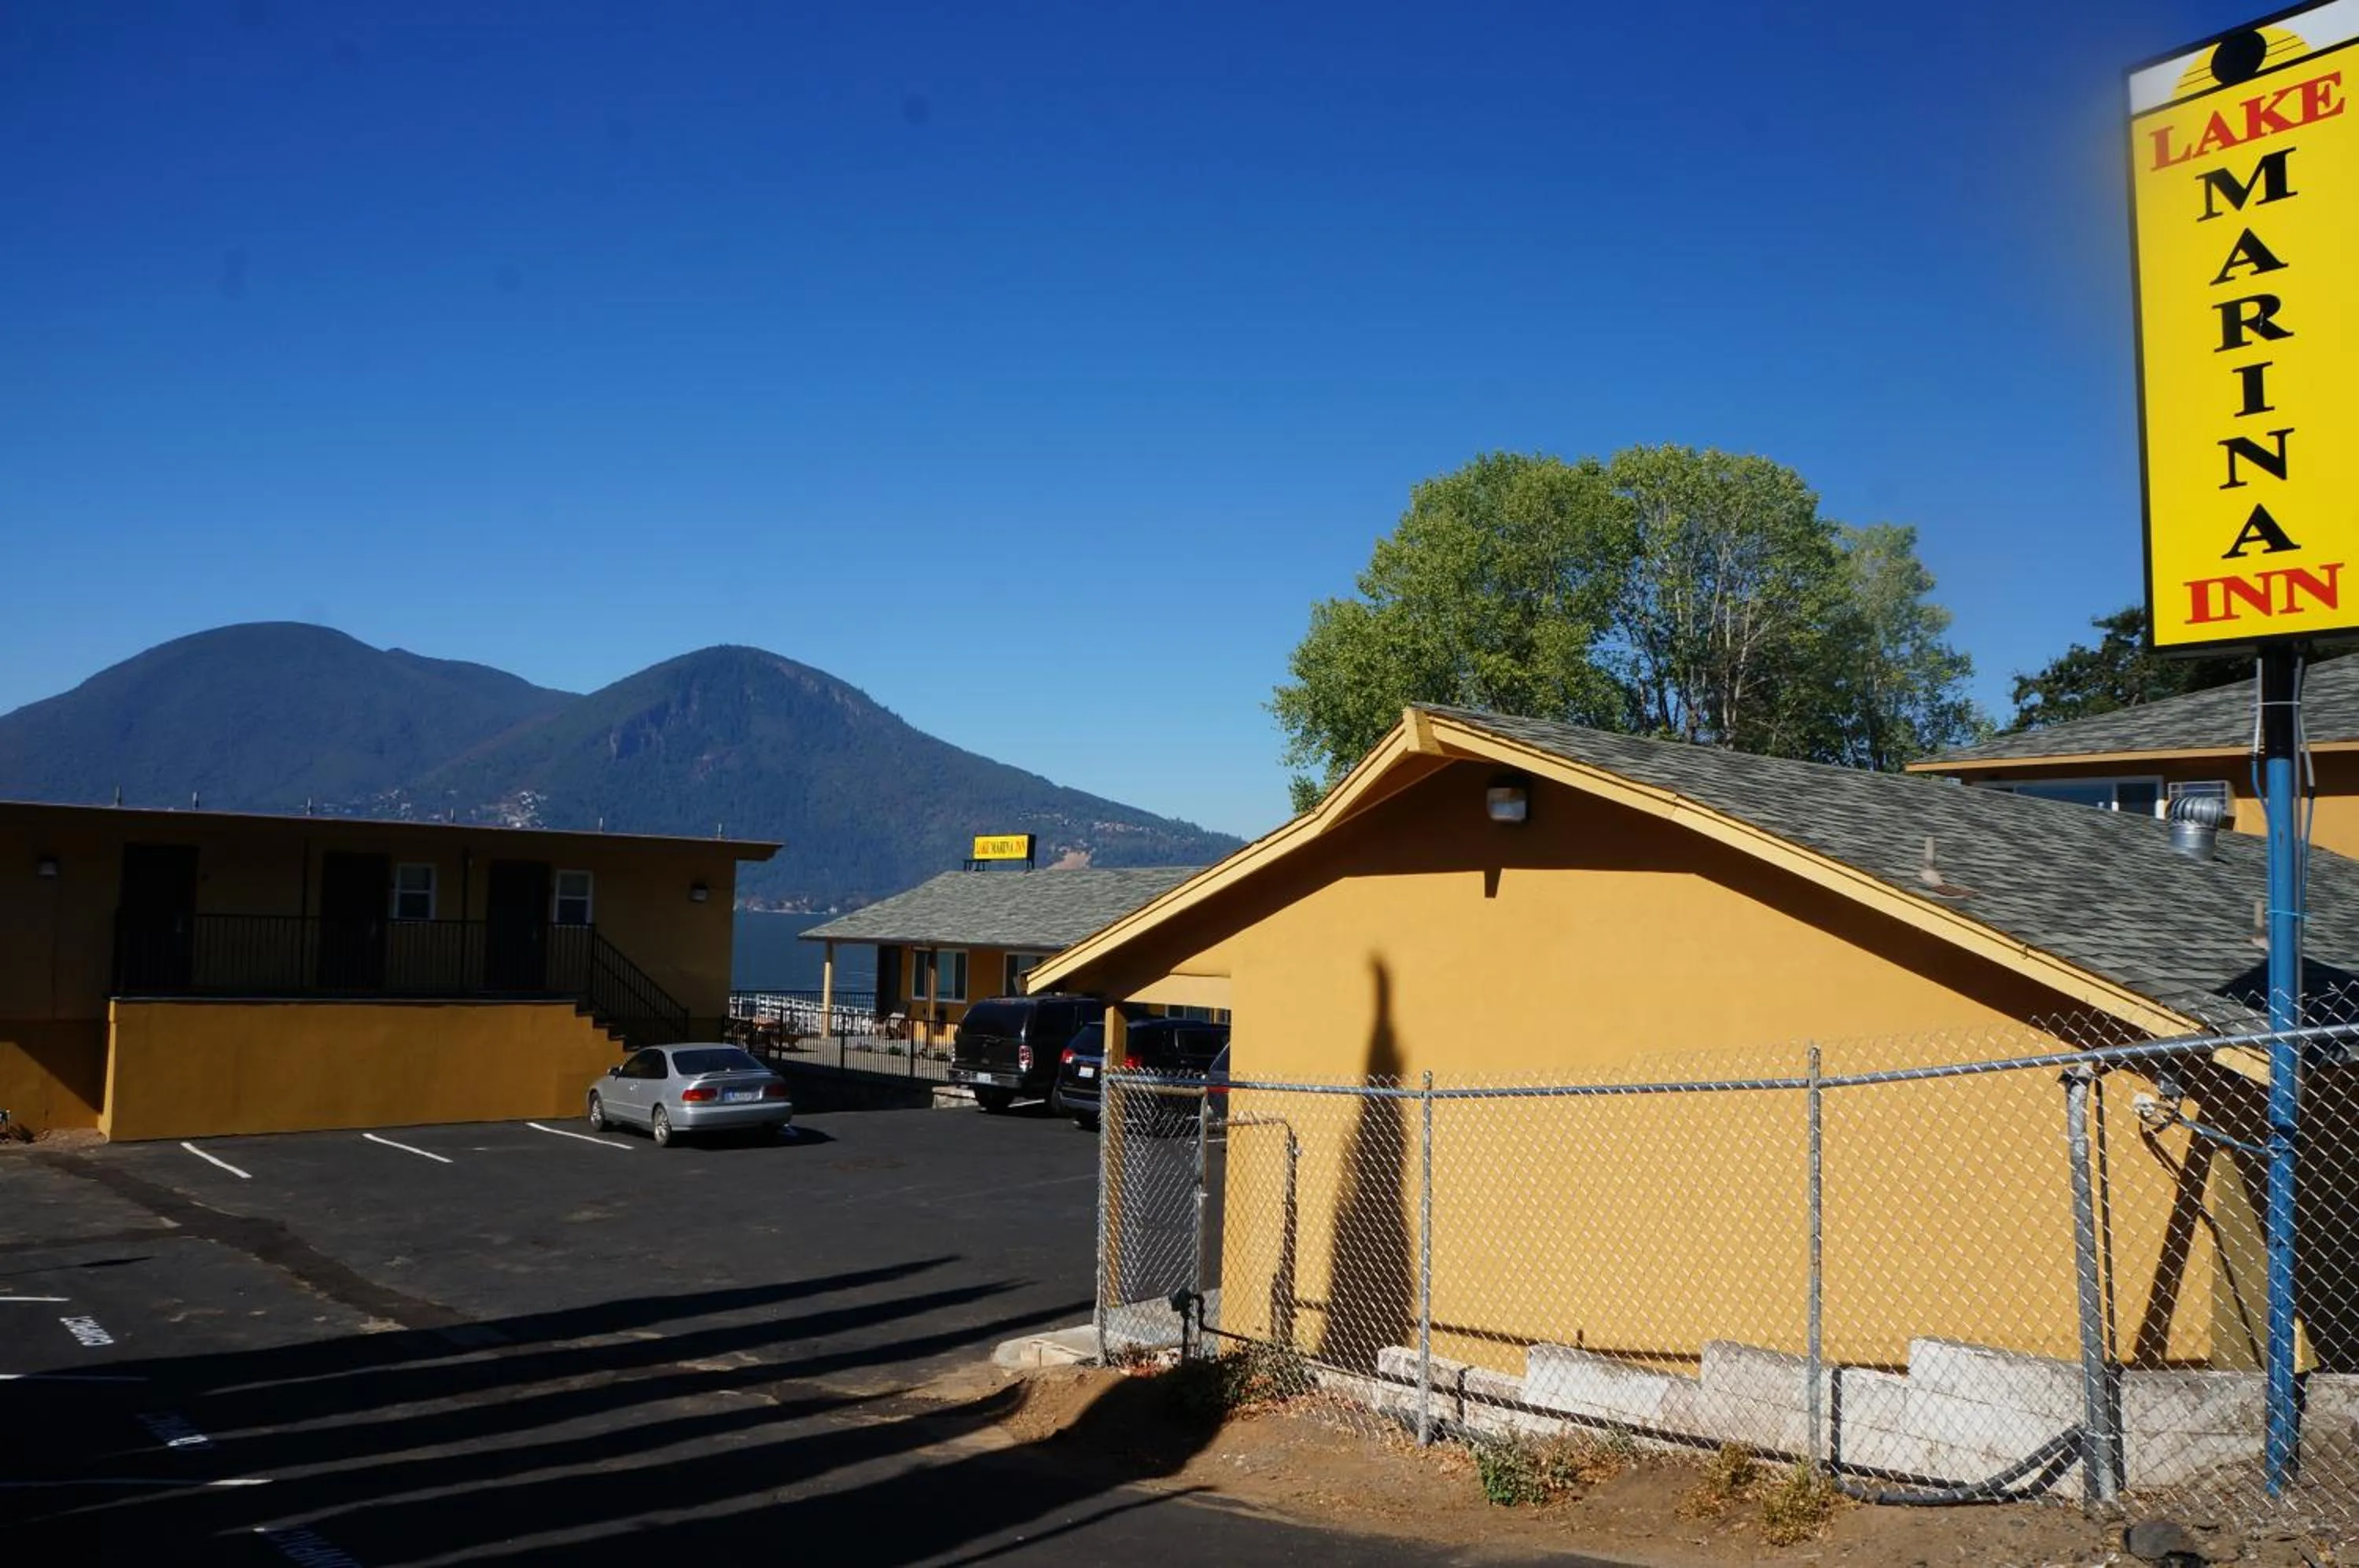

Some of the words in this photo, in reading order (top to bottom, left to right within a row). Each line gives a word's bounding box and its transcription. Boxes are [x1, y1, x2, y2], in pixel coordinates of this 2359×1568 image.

[2150, 72, 2346, 171] LAKE
[2195, 147, 2302, 559] MARINA
[2183, 562, 2345, 624] INN
